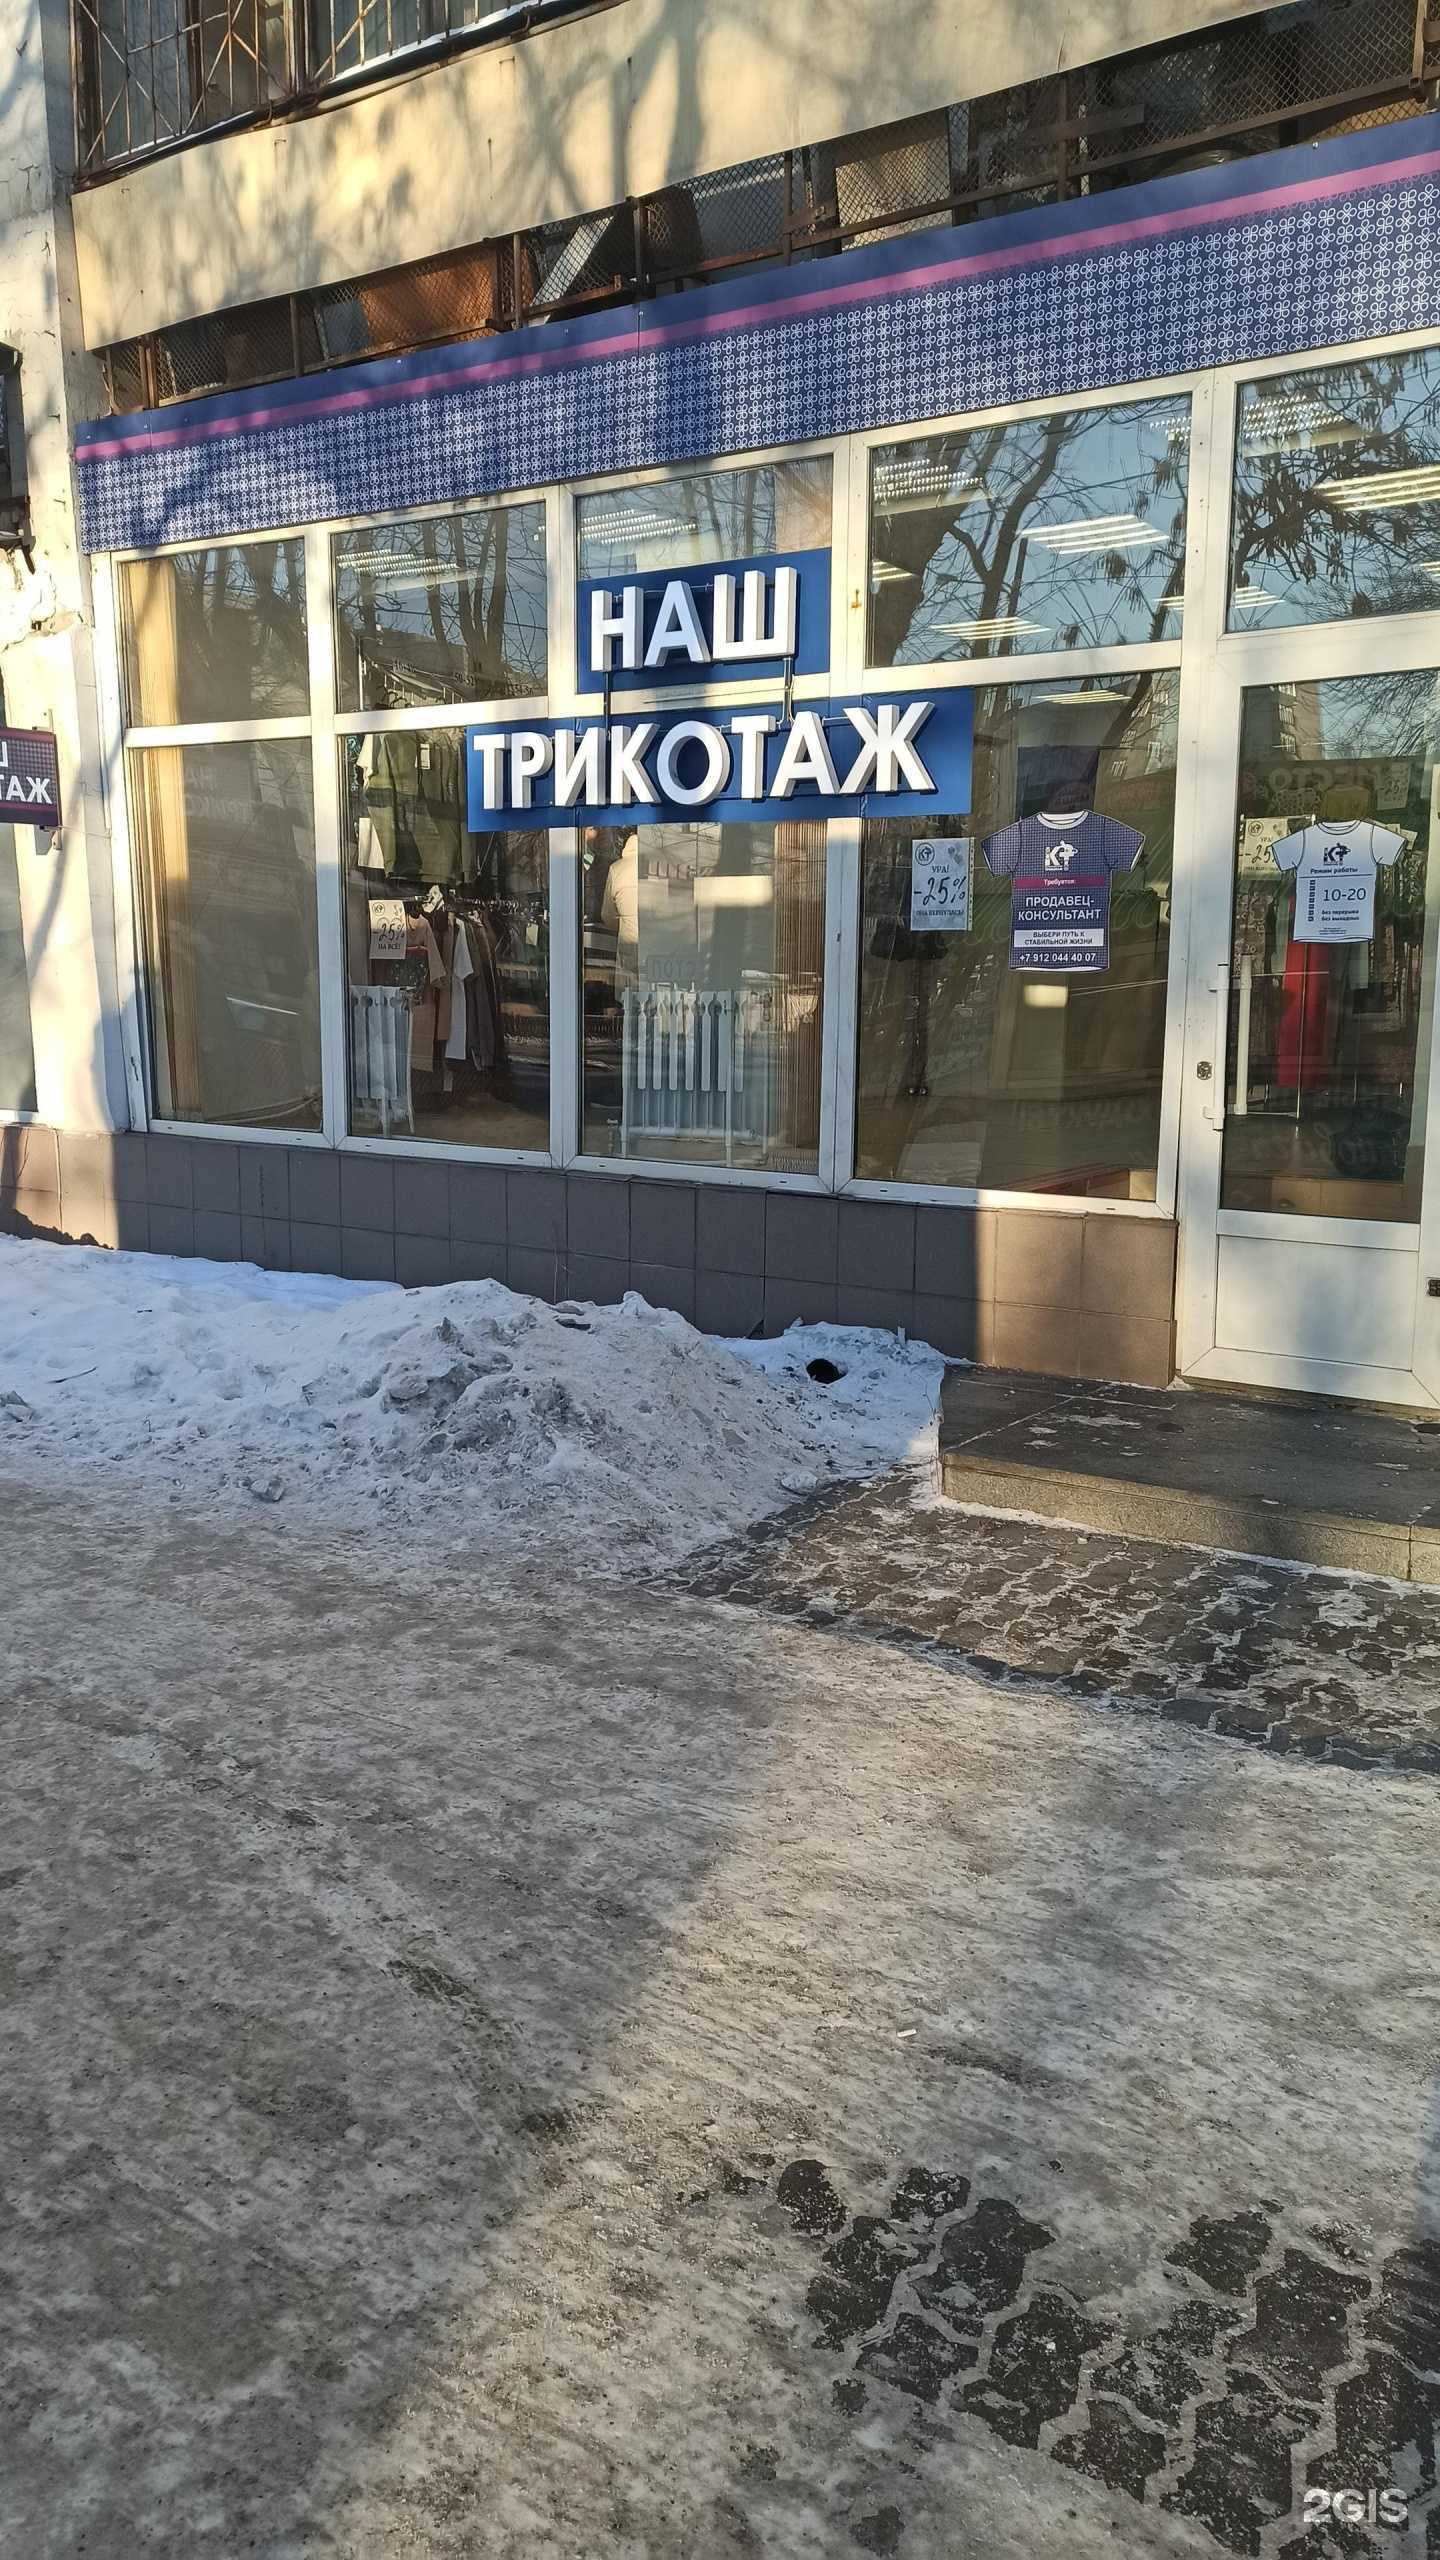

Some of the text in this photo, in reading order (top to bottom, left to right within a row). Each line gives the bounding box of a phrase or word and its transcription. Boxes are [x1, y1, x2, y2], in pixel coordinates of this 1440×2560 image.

[590, 566, 798, 672] НАШ
[473, 701, 938, 809] ТРИКОТАЖ
[1245, 844, 1274, 864] -25
[931, 864, 950, 873] УРА!
[913, 876, 967, 906] -25%
[1323, 888, 1366, 901] 10-20
[1025, 895, 1094, 908] ПРОДАВЕЦ-
[1018, 909, 1102, 921] КОНСУЛЬТАНТ
[372, 923, 405, 941] -25%
[1025, 938, 1068, 946] СТАБИЛЬНОЙ
[1020, 953, 1096, 962] +7 912 044 40 07
